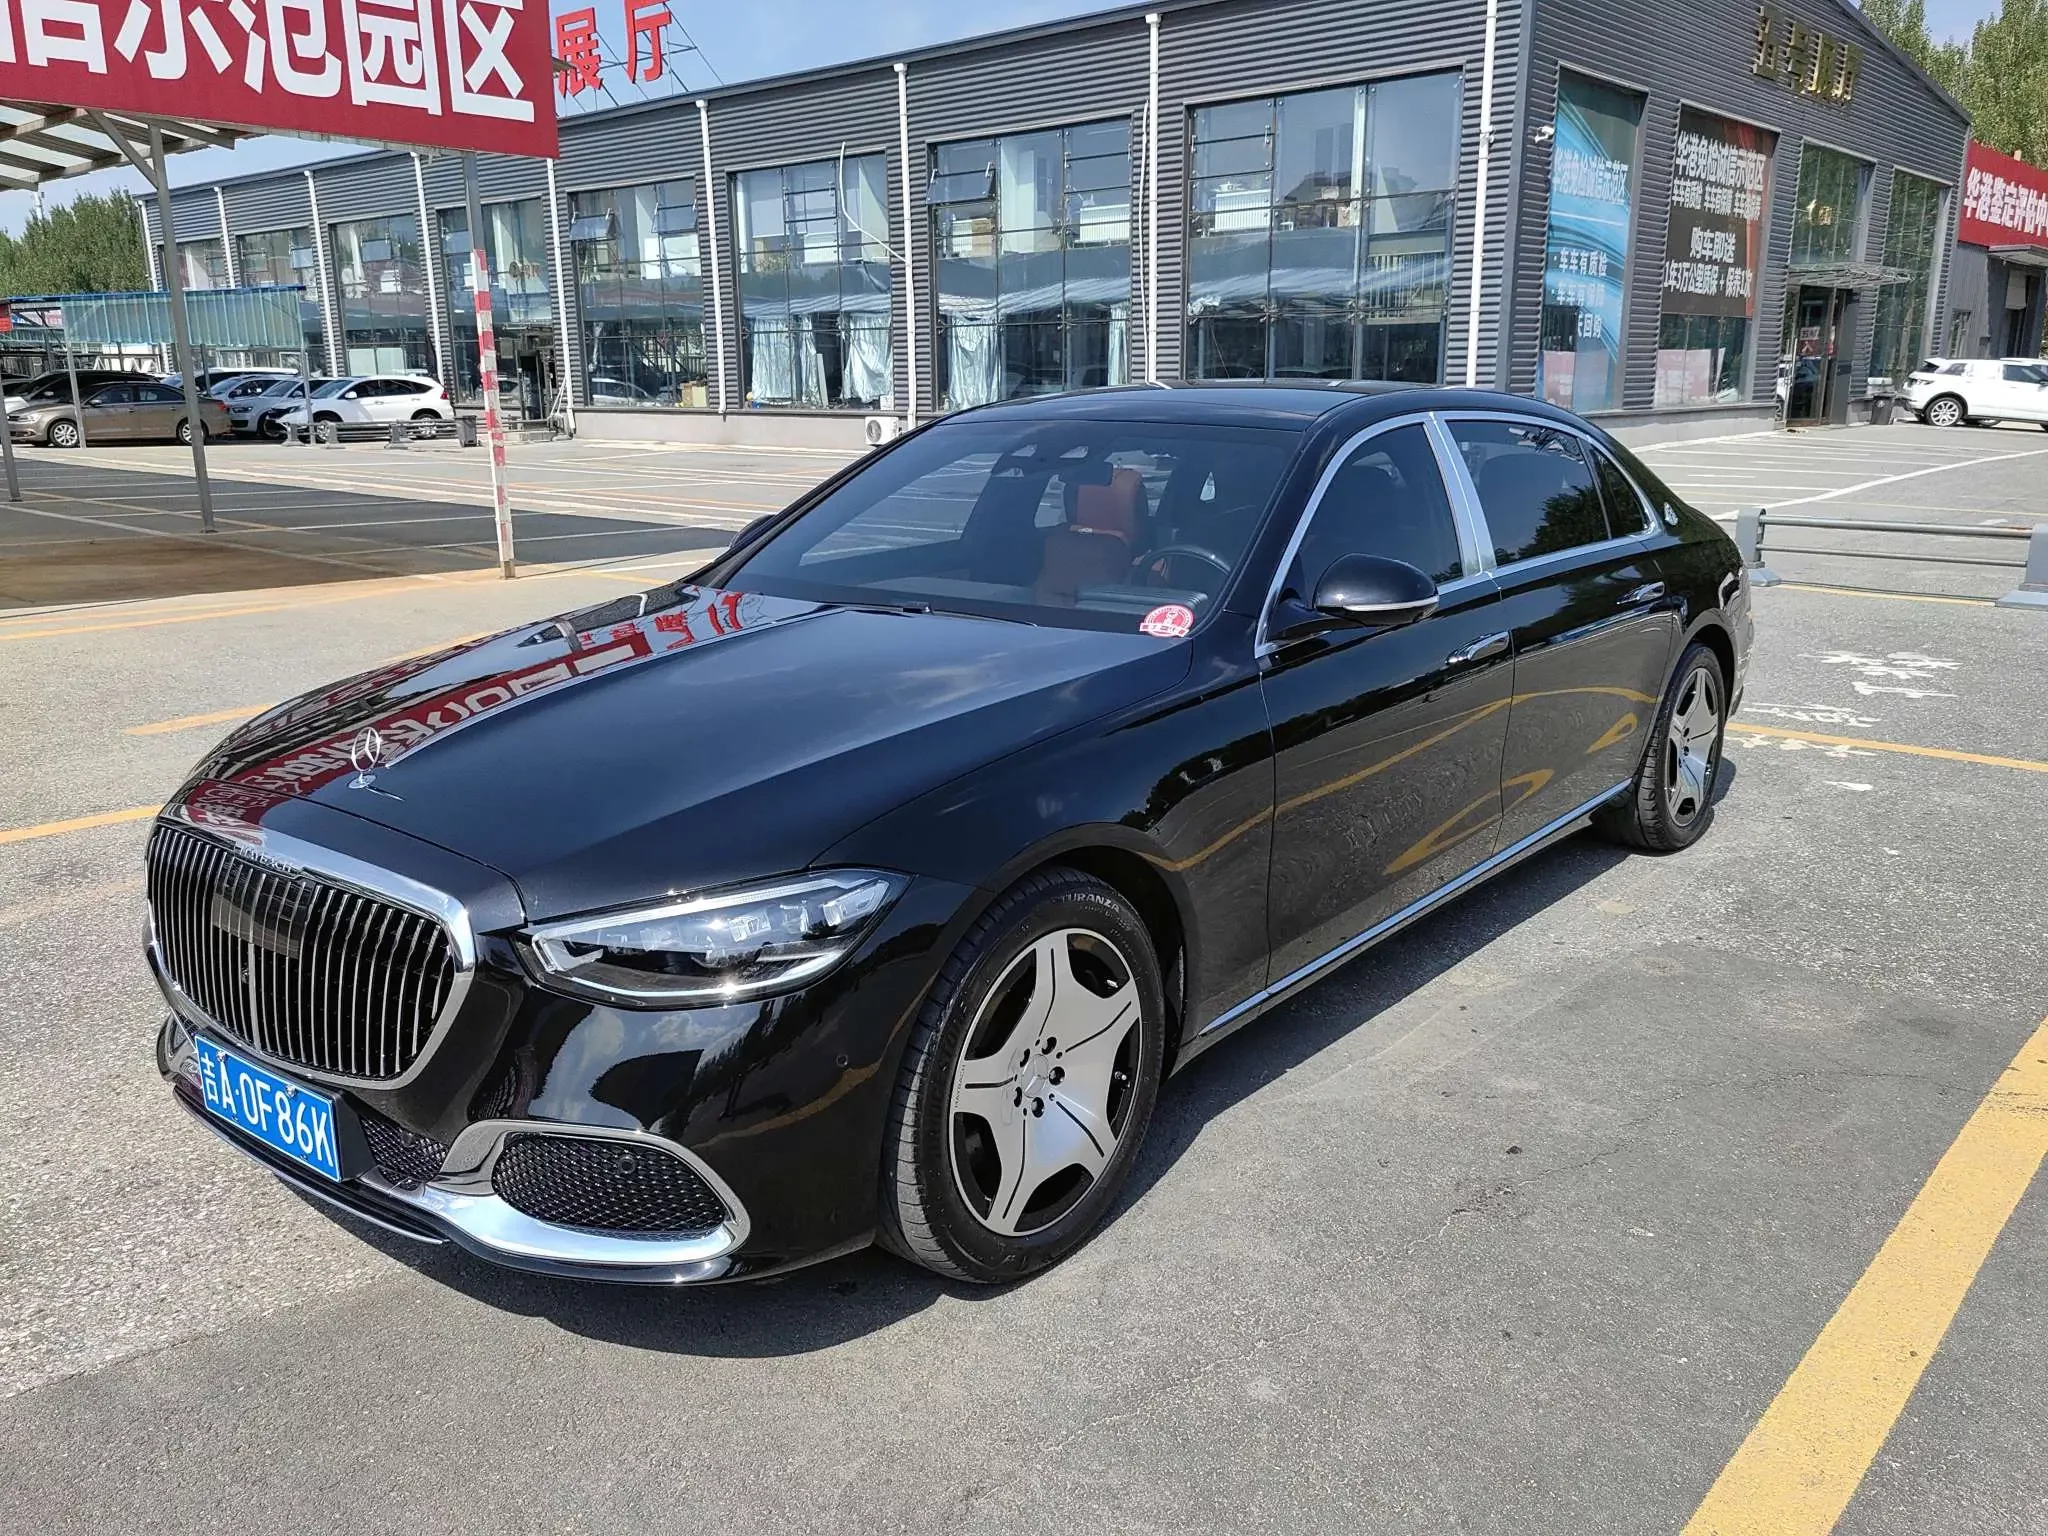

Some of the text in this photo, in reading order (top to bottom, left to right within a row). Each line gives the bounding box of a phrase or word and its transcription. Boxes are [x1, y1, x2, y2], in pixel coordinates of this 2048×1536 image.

[556, 0, 672, 98] 展厅
[1676, 130, 1767, 192] 华港免检诚信示范区
[1559, 247, 1607, 276] 车车有质检
[1689, 227, 1736, 263] 购车即送
[1664, 260, 1719, 296] 1年3万公里质保
[1062, 892, 1120, 914] TURANZA
